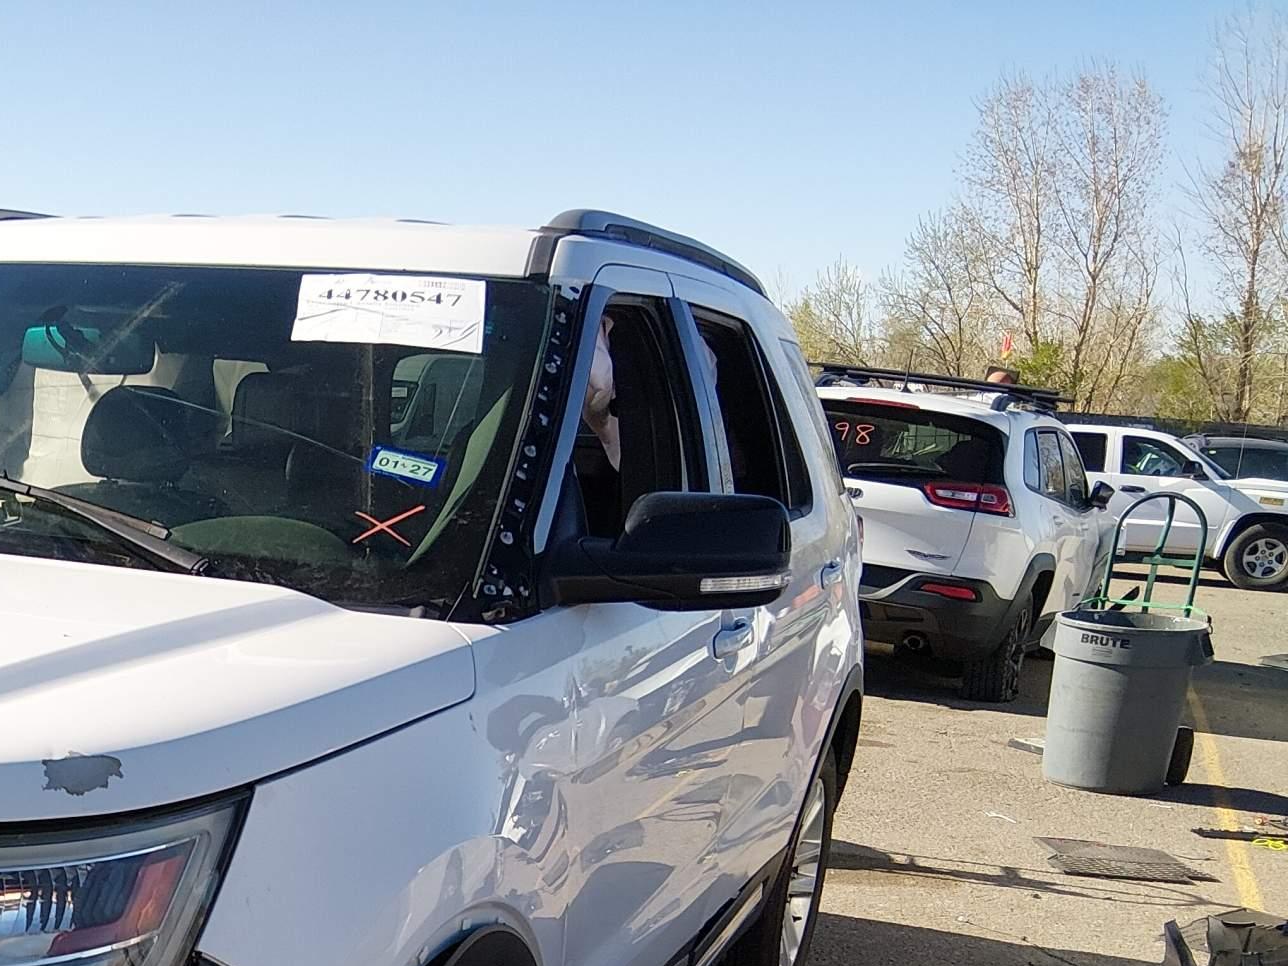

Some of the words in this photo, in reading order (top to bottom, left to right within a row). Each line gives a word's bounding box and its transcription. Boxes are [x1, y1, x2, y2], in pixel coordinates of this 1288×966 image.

[318, 288, 463, 308] 44780547
[834, 422, 875, 445] 98
[1080, 633, 1131, 650] BRUTE
